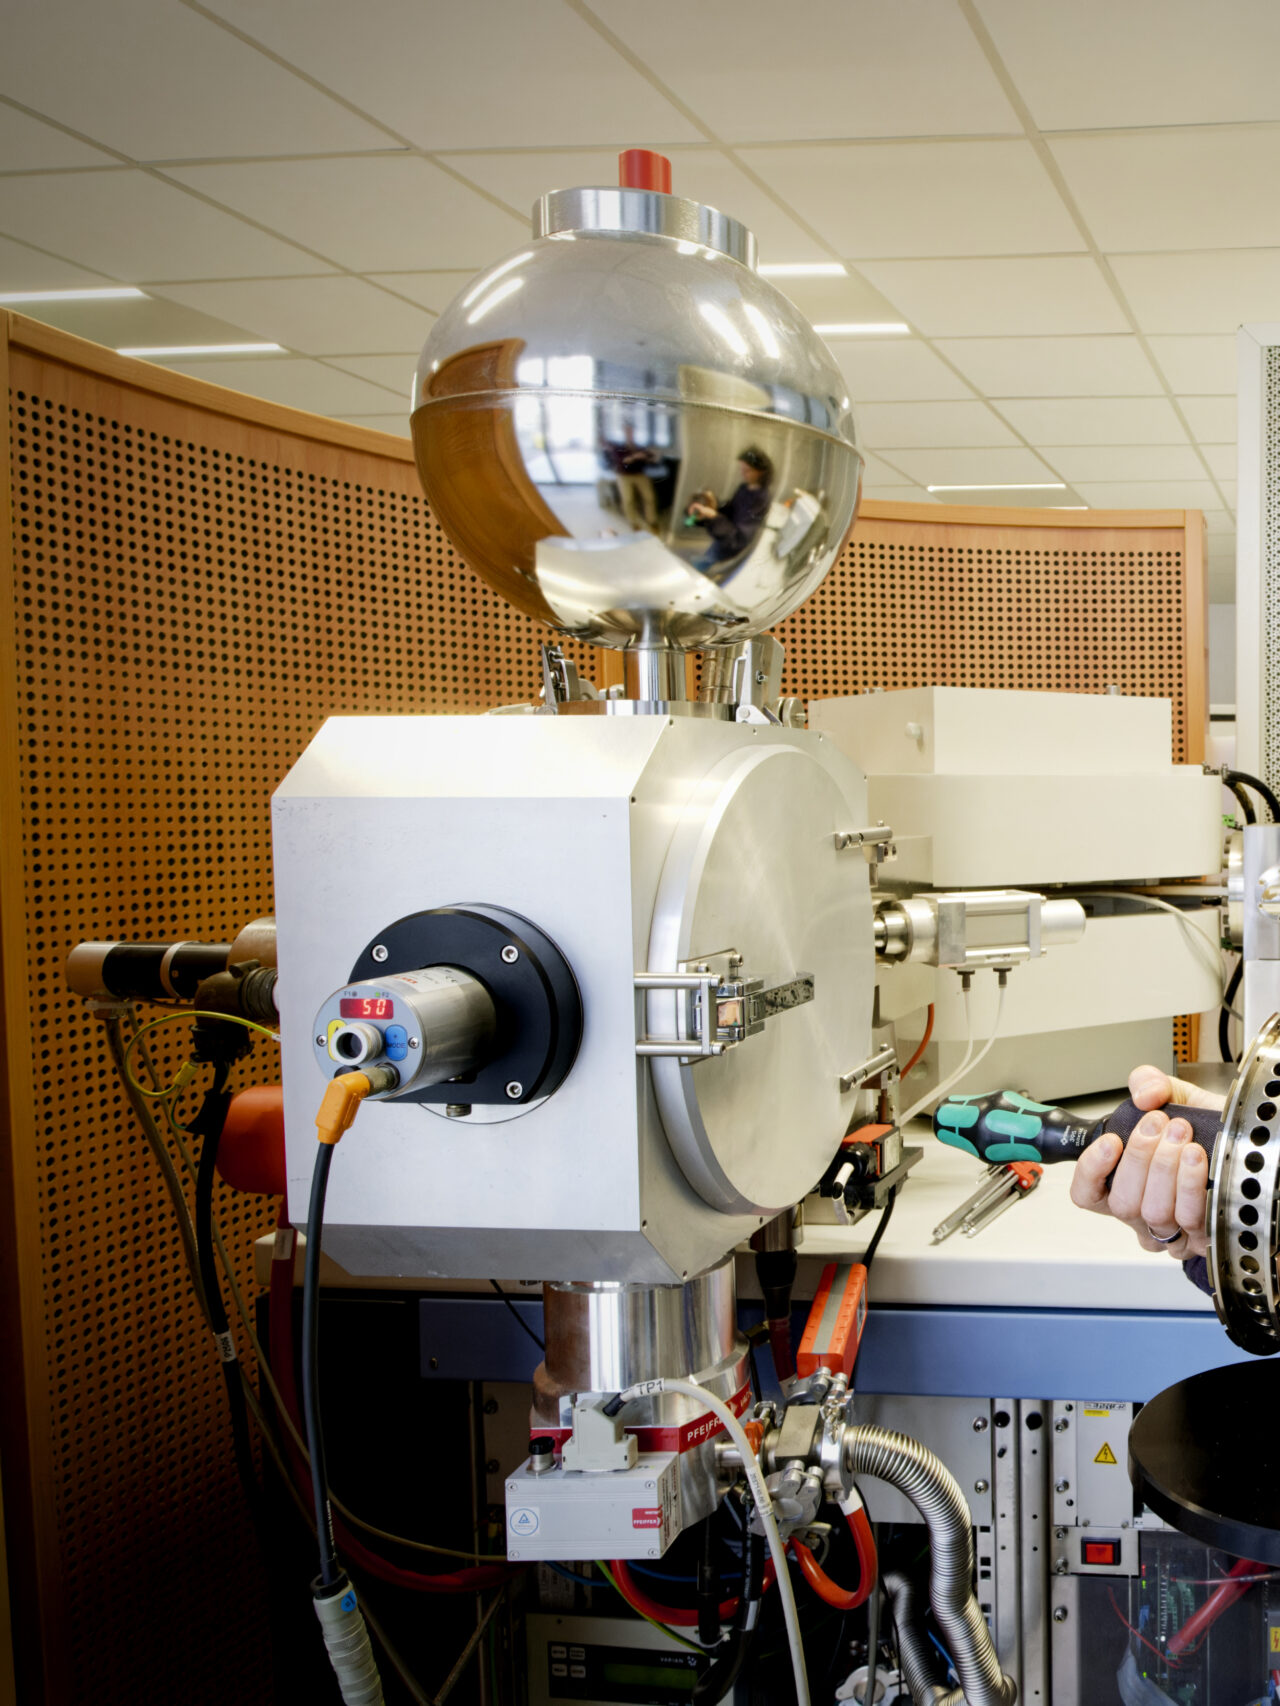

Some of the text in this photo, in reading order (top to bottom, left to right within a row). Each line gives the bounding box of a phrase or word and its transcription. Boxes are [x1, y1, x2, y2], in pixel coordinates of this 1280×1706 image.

[363, 998, 386, 1015] 50
[636, 1380, 664, 1396] TP1
[687, 1416, 723, 1442] PFEIFF
[660, 1656, 684, 1664] VARIAN
